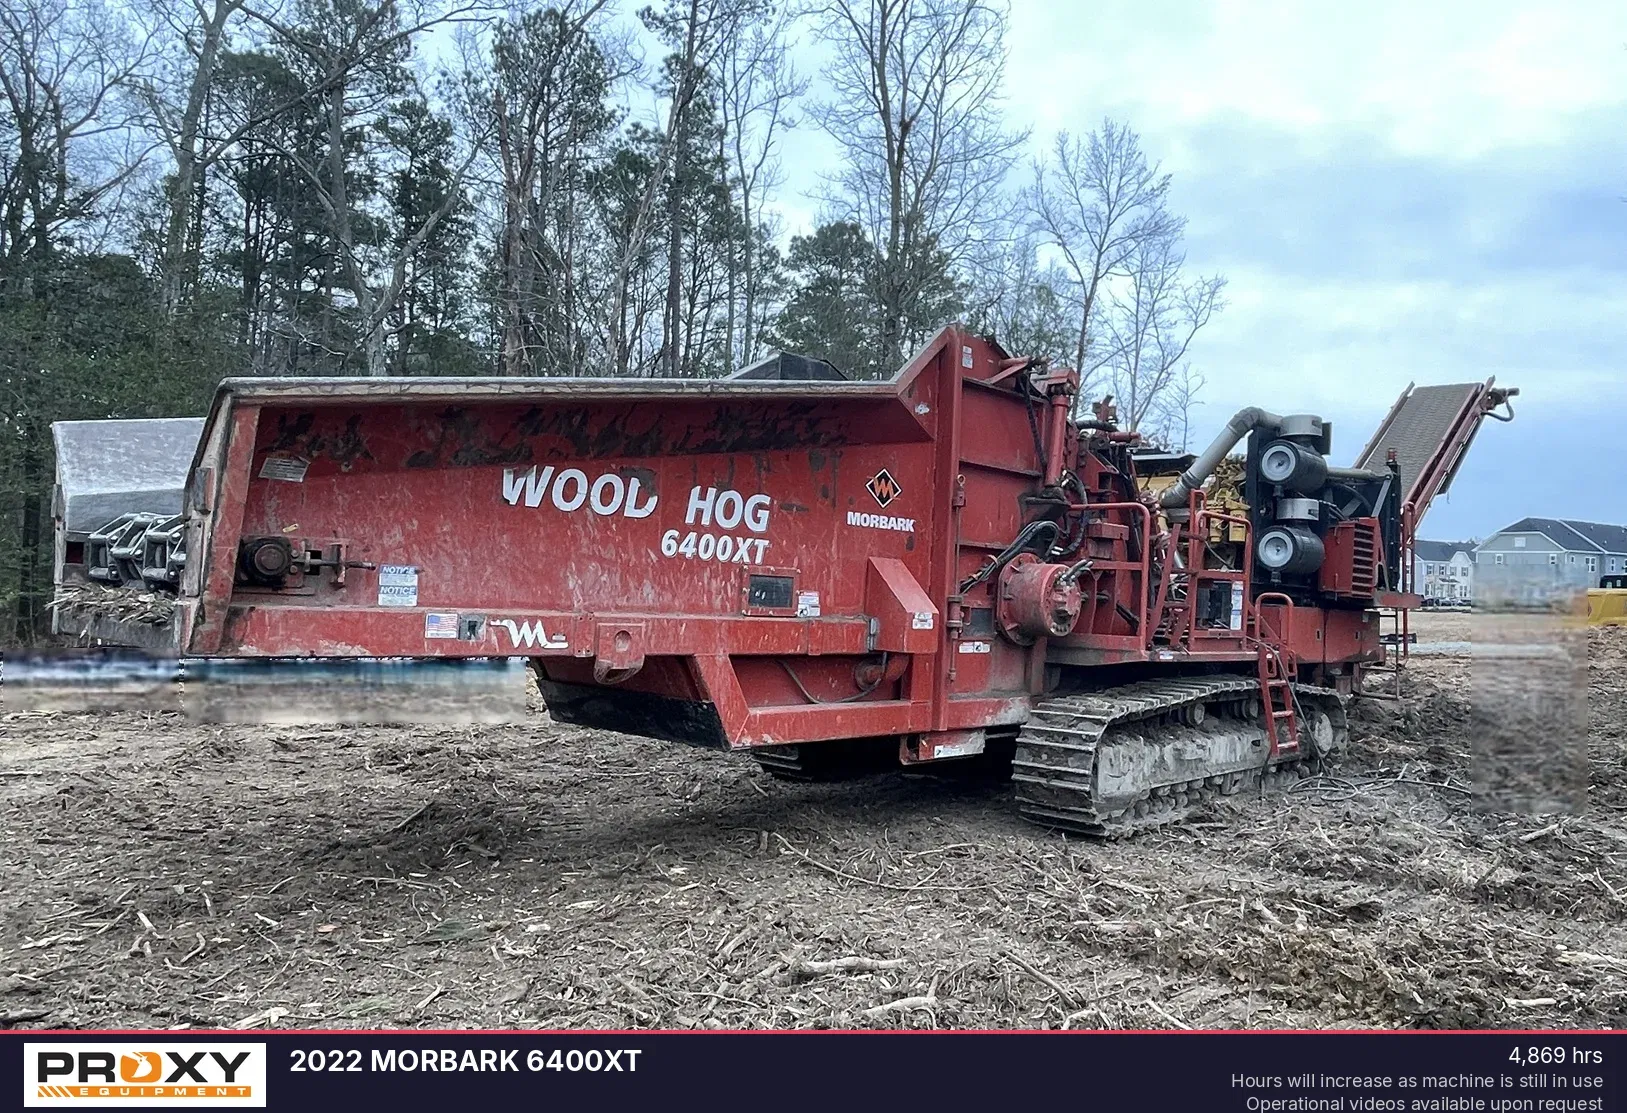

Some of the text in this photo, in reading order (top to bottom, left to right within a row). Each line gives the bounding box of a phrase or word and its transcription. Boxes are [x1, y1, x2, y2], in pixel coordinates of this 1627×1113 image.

[502, 465, 771, 532] WOOD HOG
[847, 511, 915, 533] MORBARK
[661, 529, 770, 565] 6400XT
[382, 566, 416, 574] NOTICE
[380, 586, 416, 595] NOTICE
